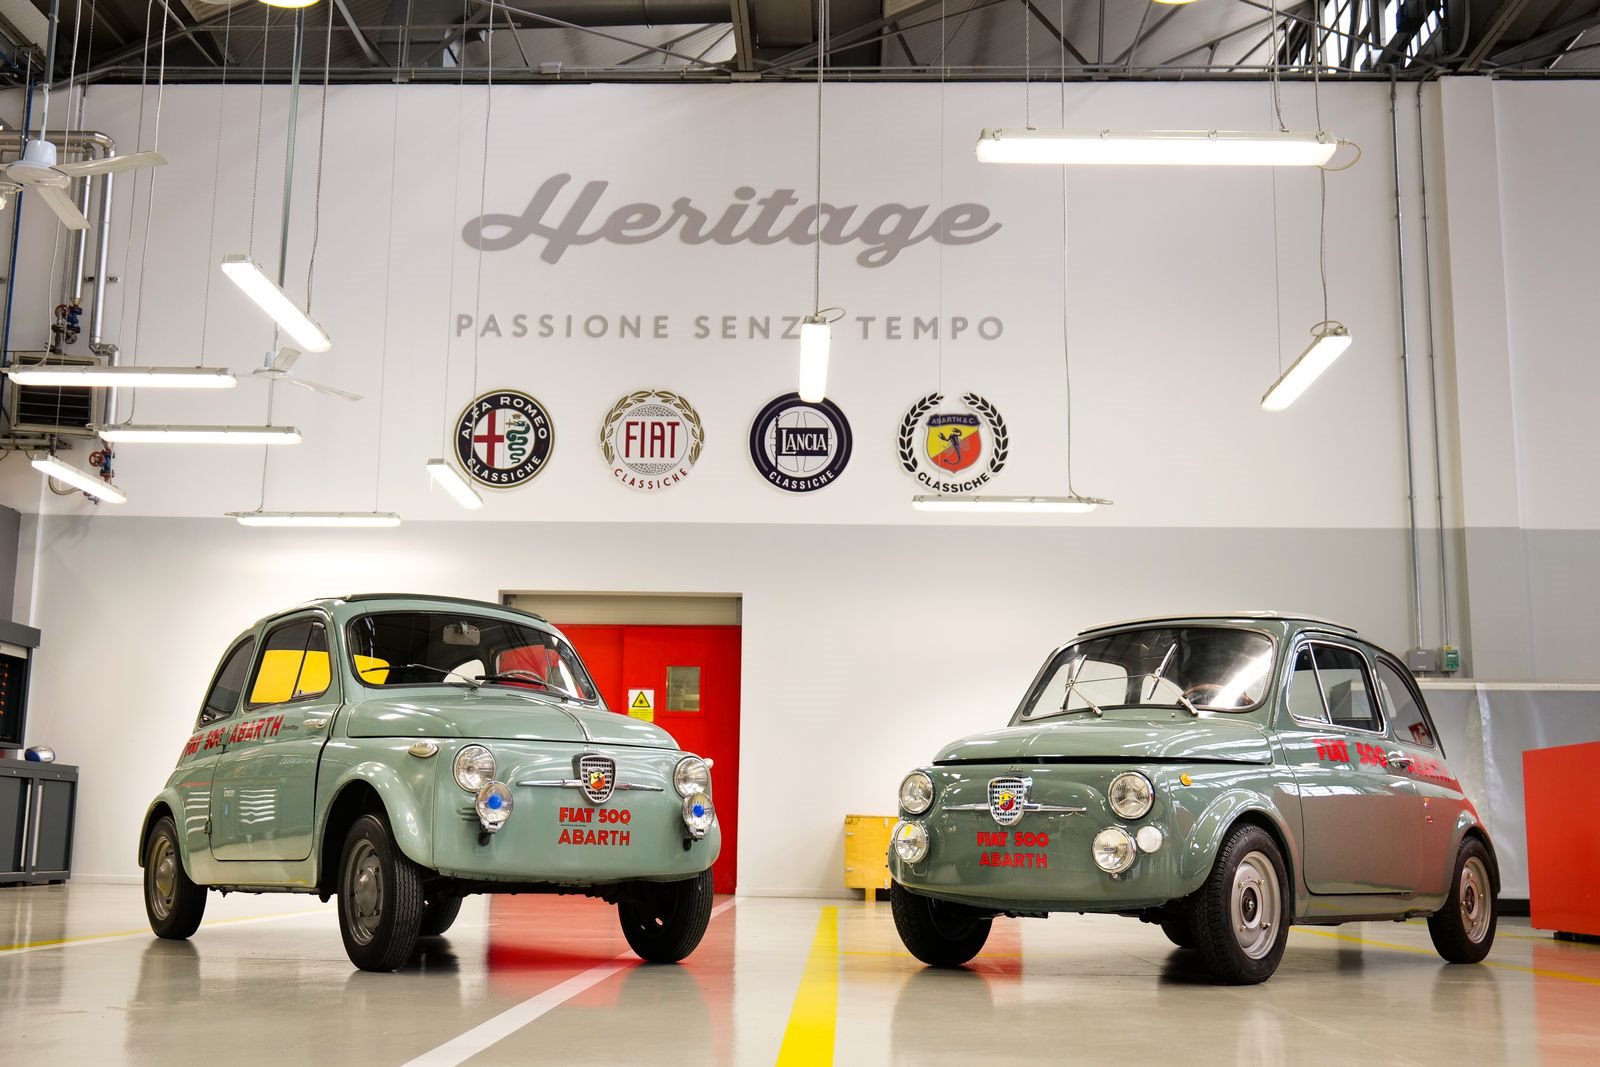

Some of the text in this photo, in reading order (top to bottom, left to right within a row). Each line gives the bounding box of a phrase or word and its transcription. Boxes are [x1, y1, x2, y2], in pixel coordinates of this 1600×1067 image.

[461, 173, 1002, 268] Heritage
[456, 313, 1004, 341] PASSIONE SENZ TEMPO
[461, 396, 547, 439] ALFA ROMEO
[625, 421, 680, 458] FIAT
[781, 429, 827, 454] LANCIA
[467, 455, 541, 482] CLASSICHE
[614, 467, 688, 490] CLASSICHE
[769, 470, 835, 490] CLASSICHE
[917, 472, 990, 493] CLASSICHE
[229, 715, 285, 744] ABARTH
[559, 807, 631, 825] FIAT 500
[558, 828, 631, 847] ABARTH
[977, 831, 1050, 848] FIAT 500
[979, 851, 1048, 869] ABARTH
